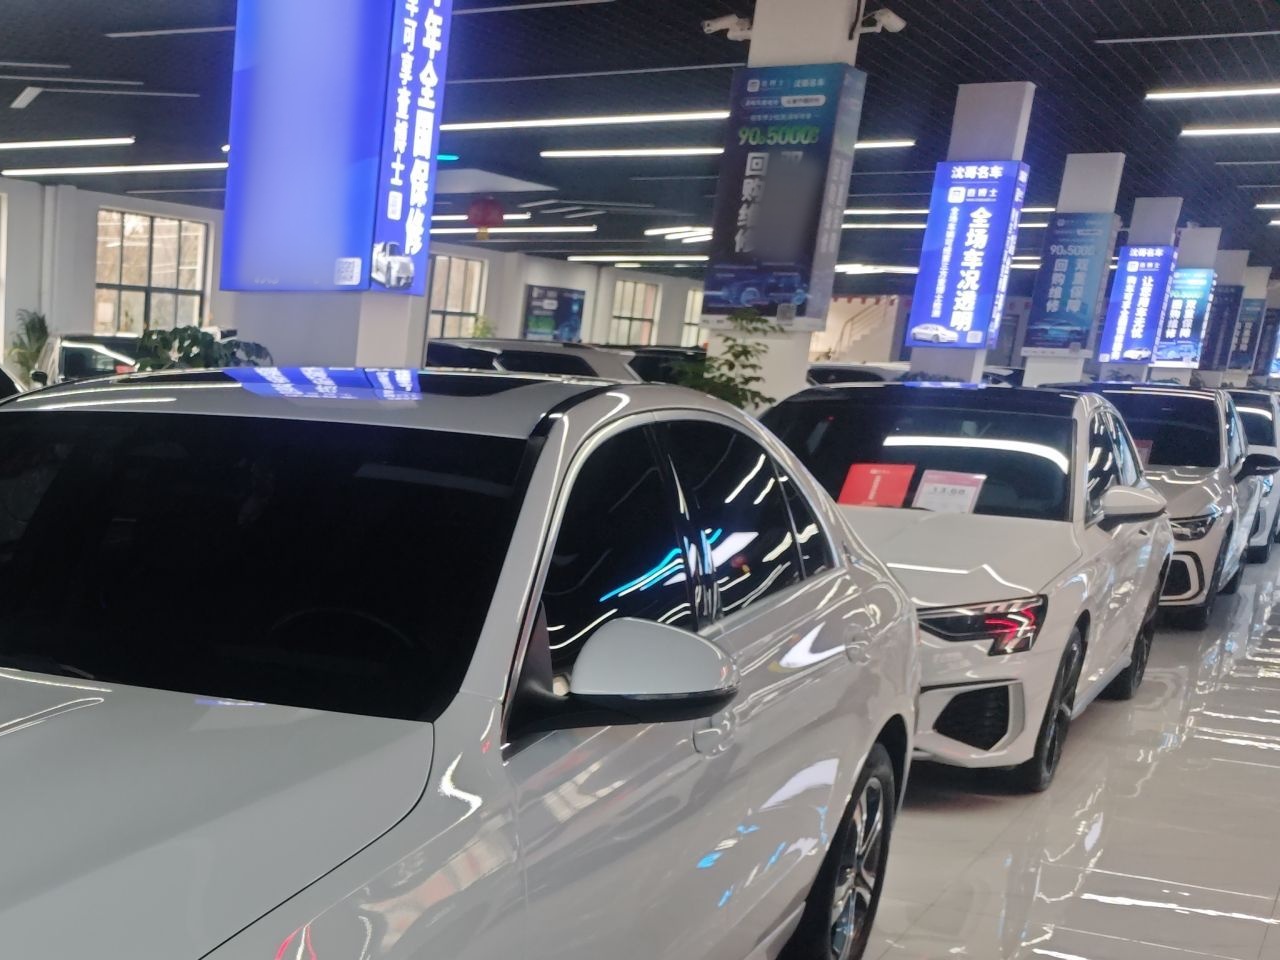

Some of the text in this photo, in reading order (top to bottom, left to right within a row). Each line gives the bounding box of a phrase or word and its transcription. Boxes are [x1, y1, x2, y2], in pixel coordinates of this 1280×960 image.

[405, 0, 443, 255] 年全国保修
[949, 206, 993, 332] 全场车况透明
